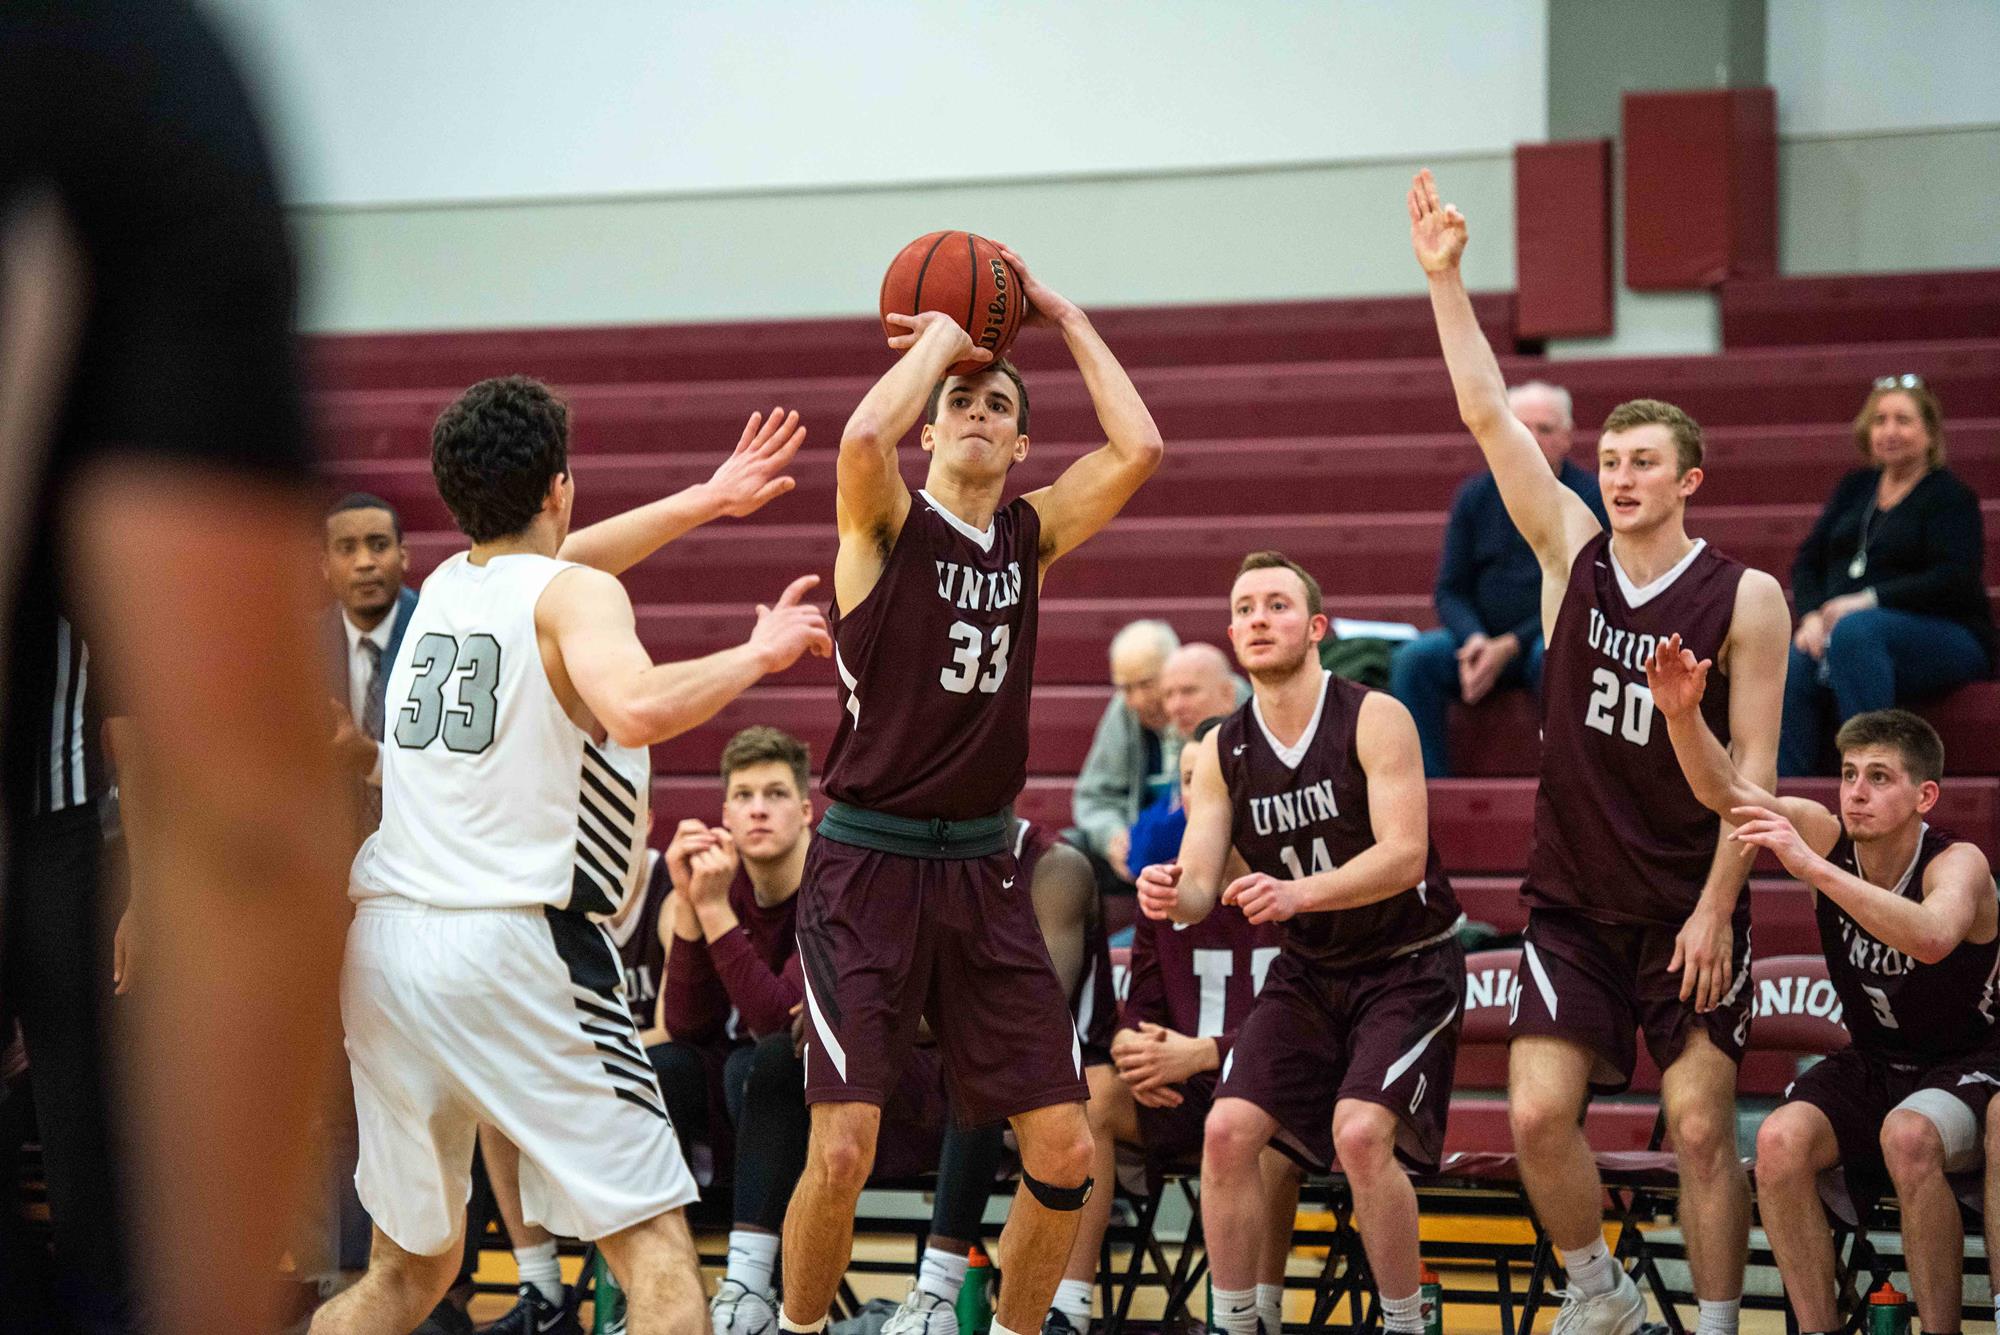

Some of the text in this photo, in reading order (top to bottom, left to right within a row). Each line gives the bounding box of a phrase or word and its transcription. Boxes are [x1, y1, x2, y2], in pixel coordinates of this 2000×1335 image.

[978, 257, 1007, 350] Wilson
[394, 632, 501, 755] 33
[940, 620, 1010, 694] 33
[1585, 666, 1655, 747] 20
[1249, 778, 1339, 836] UNION
[1751, 976, 1847, 1030] NIO
[1861, 983, 1899, 1029] 3
